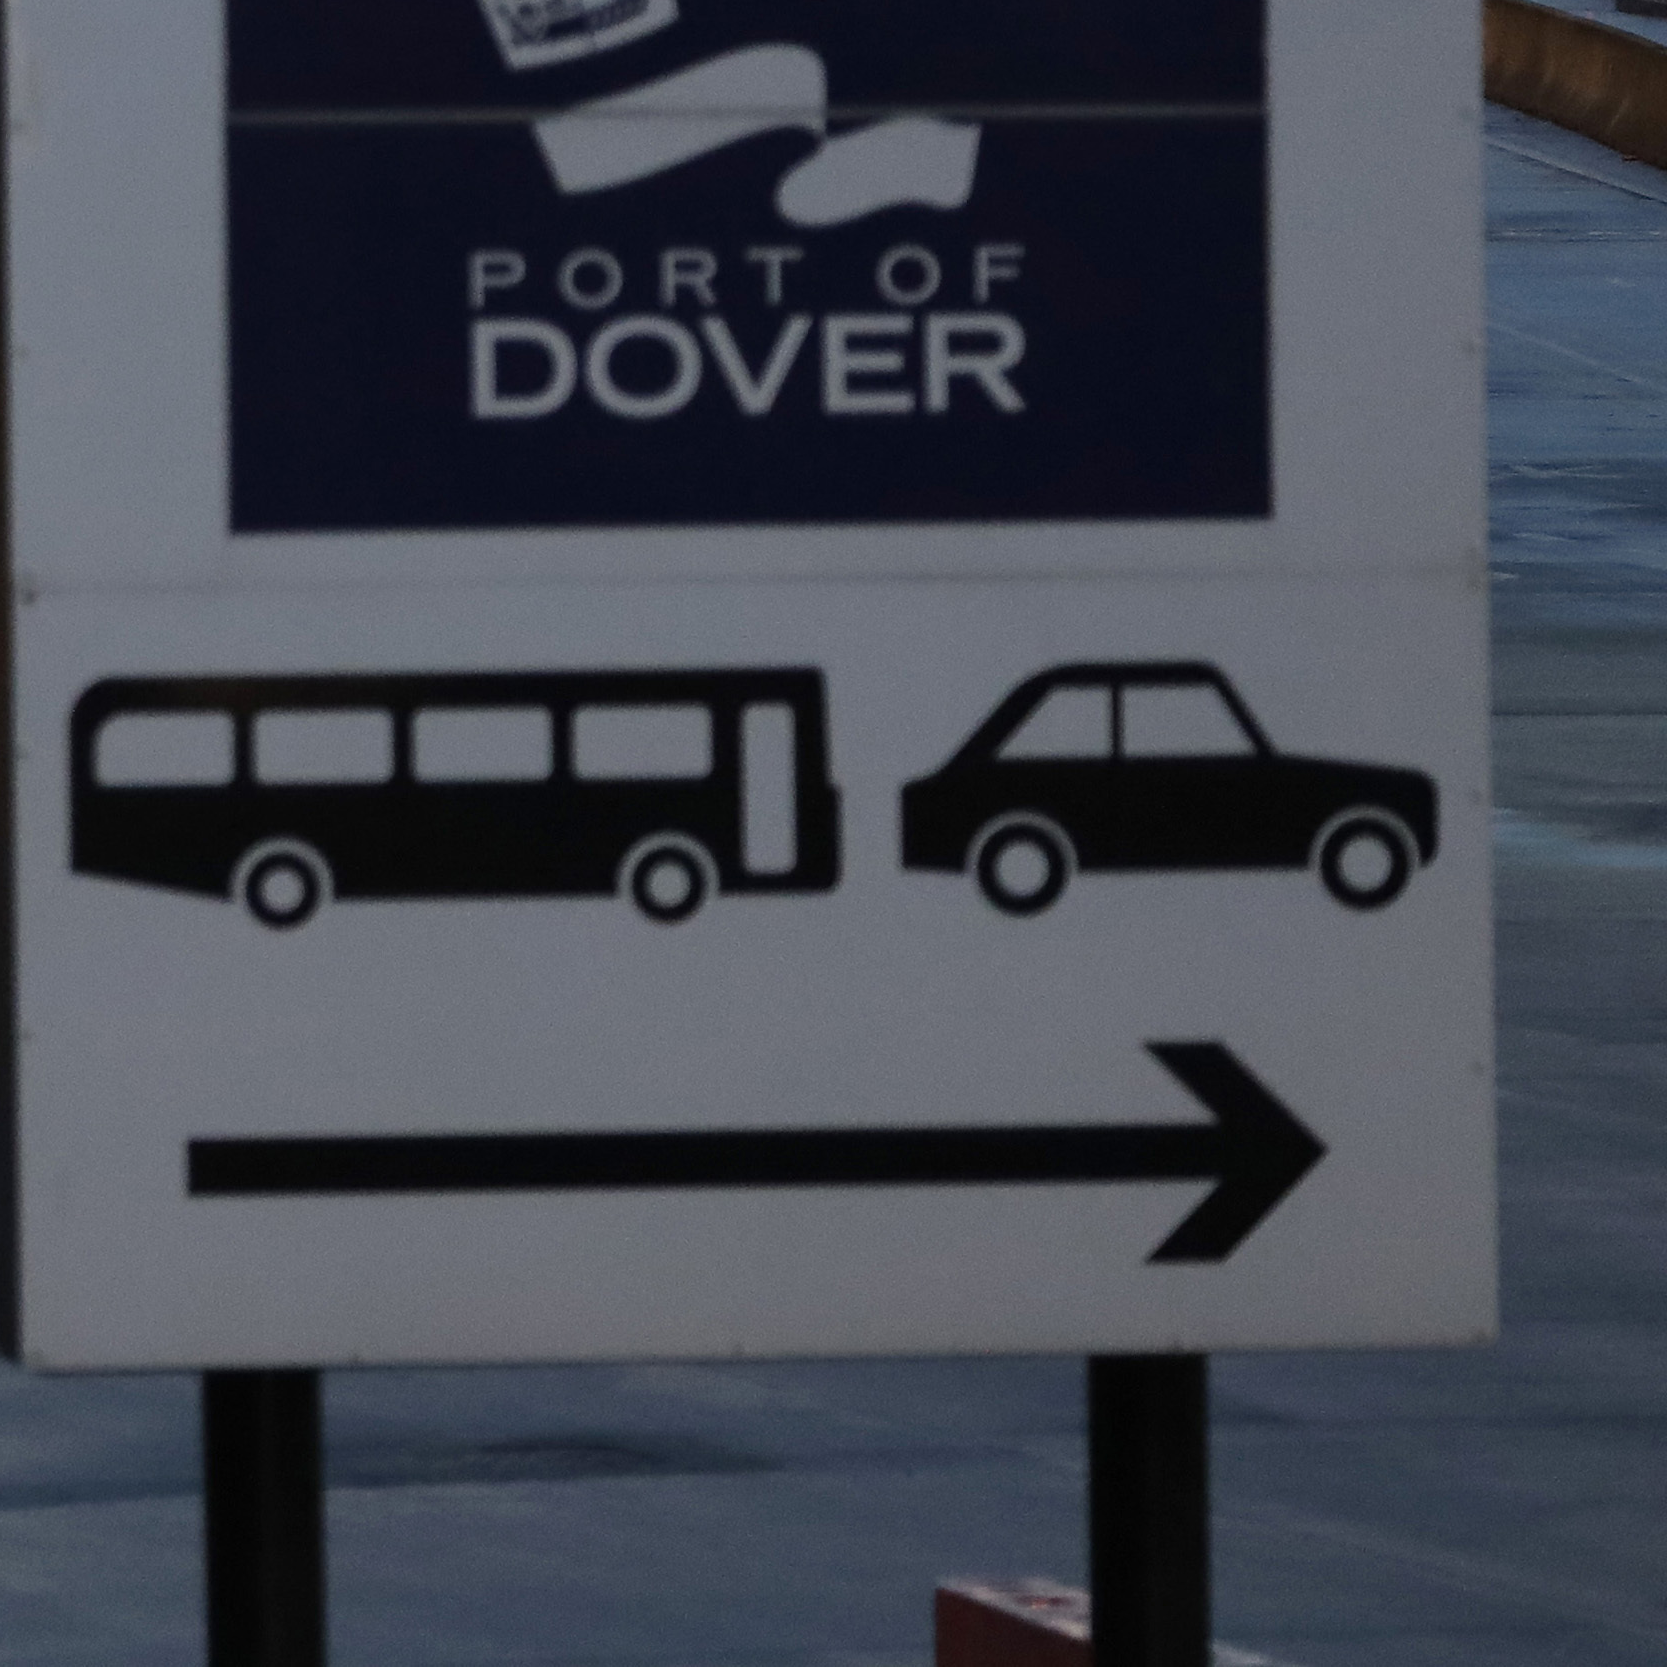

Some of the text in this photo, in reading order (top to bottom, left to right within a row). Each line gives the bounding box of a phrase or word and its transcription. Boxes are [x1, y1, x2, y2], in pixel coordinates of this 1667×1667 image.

[468, 243, 1026, 308] PORT OF
[470, 314, 1027, 421] DOVER
